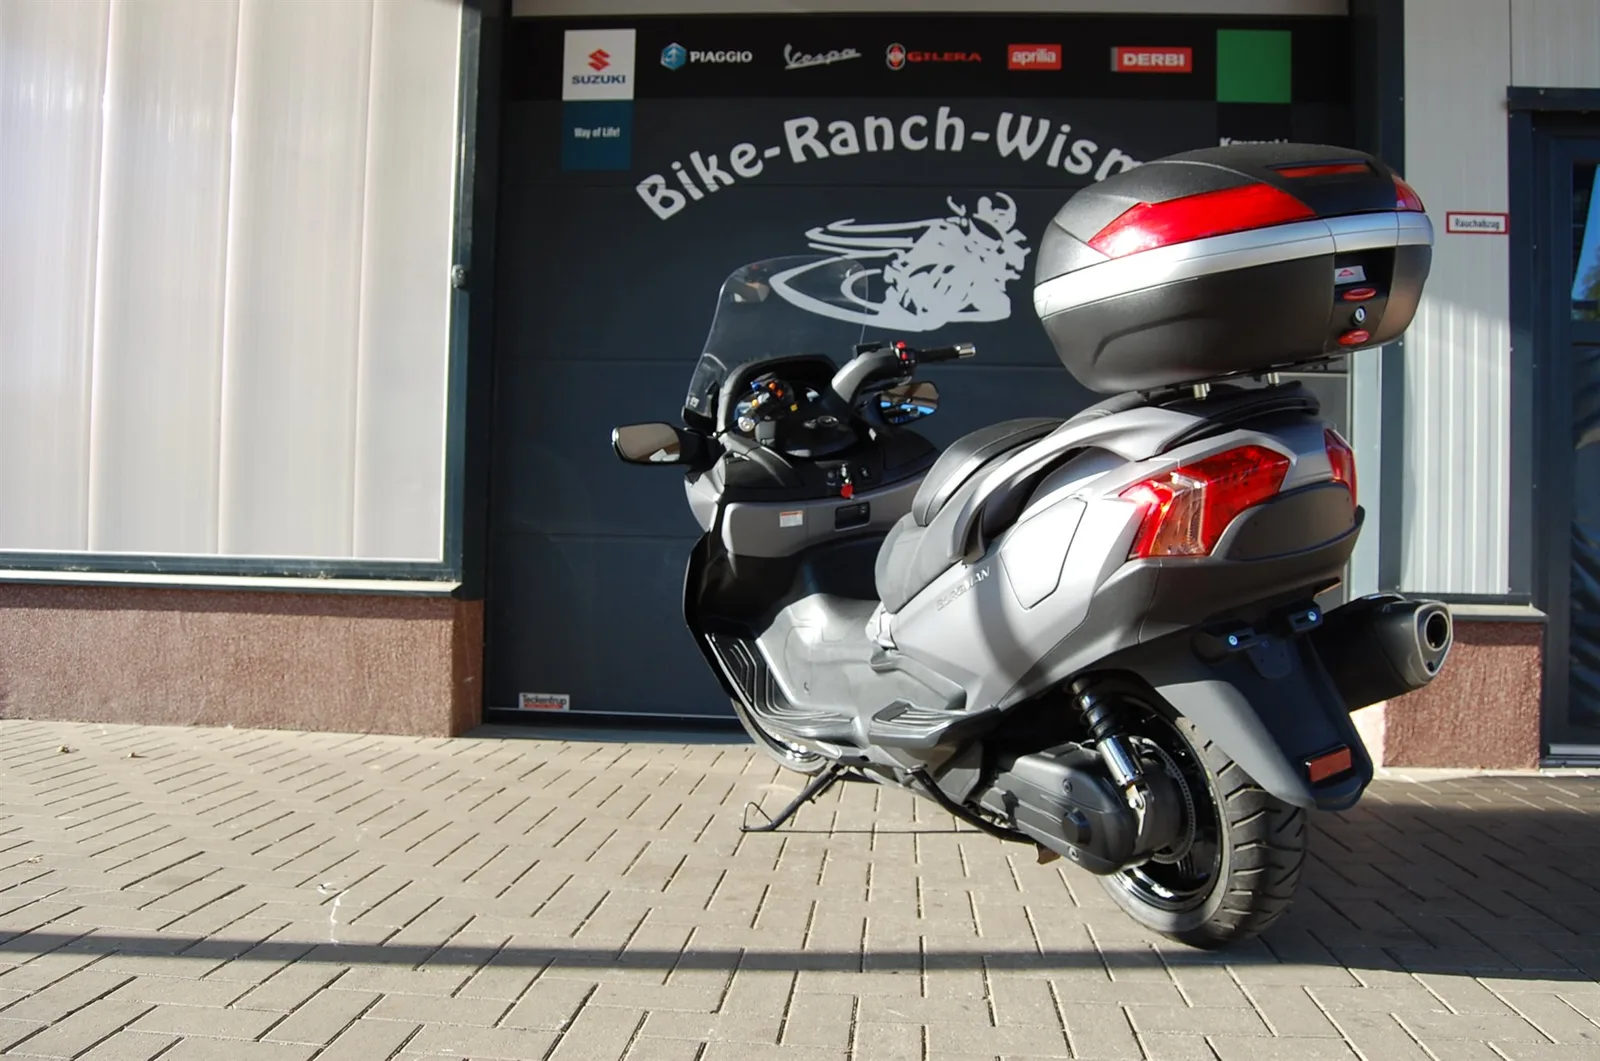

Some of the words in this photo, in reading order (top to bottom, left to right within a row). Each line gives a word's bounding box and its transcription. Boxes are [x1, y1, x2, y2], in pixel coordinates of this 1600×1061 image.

[689, 50, 753, 63] PIAGGIO
[783, 43, 861, 69] Vespa
[907, 51, 981, 62] GILERA
[1012, 48, 1056, 65] aprilia
[1122, 52, 1185, 67] DERBI
[571, 74, 627, 85] SUZUKI
[574, 127, 591, 139] Way
